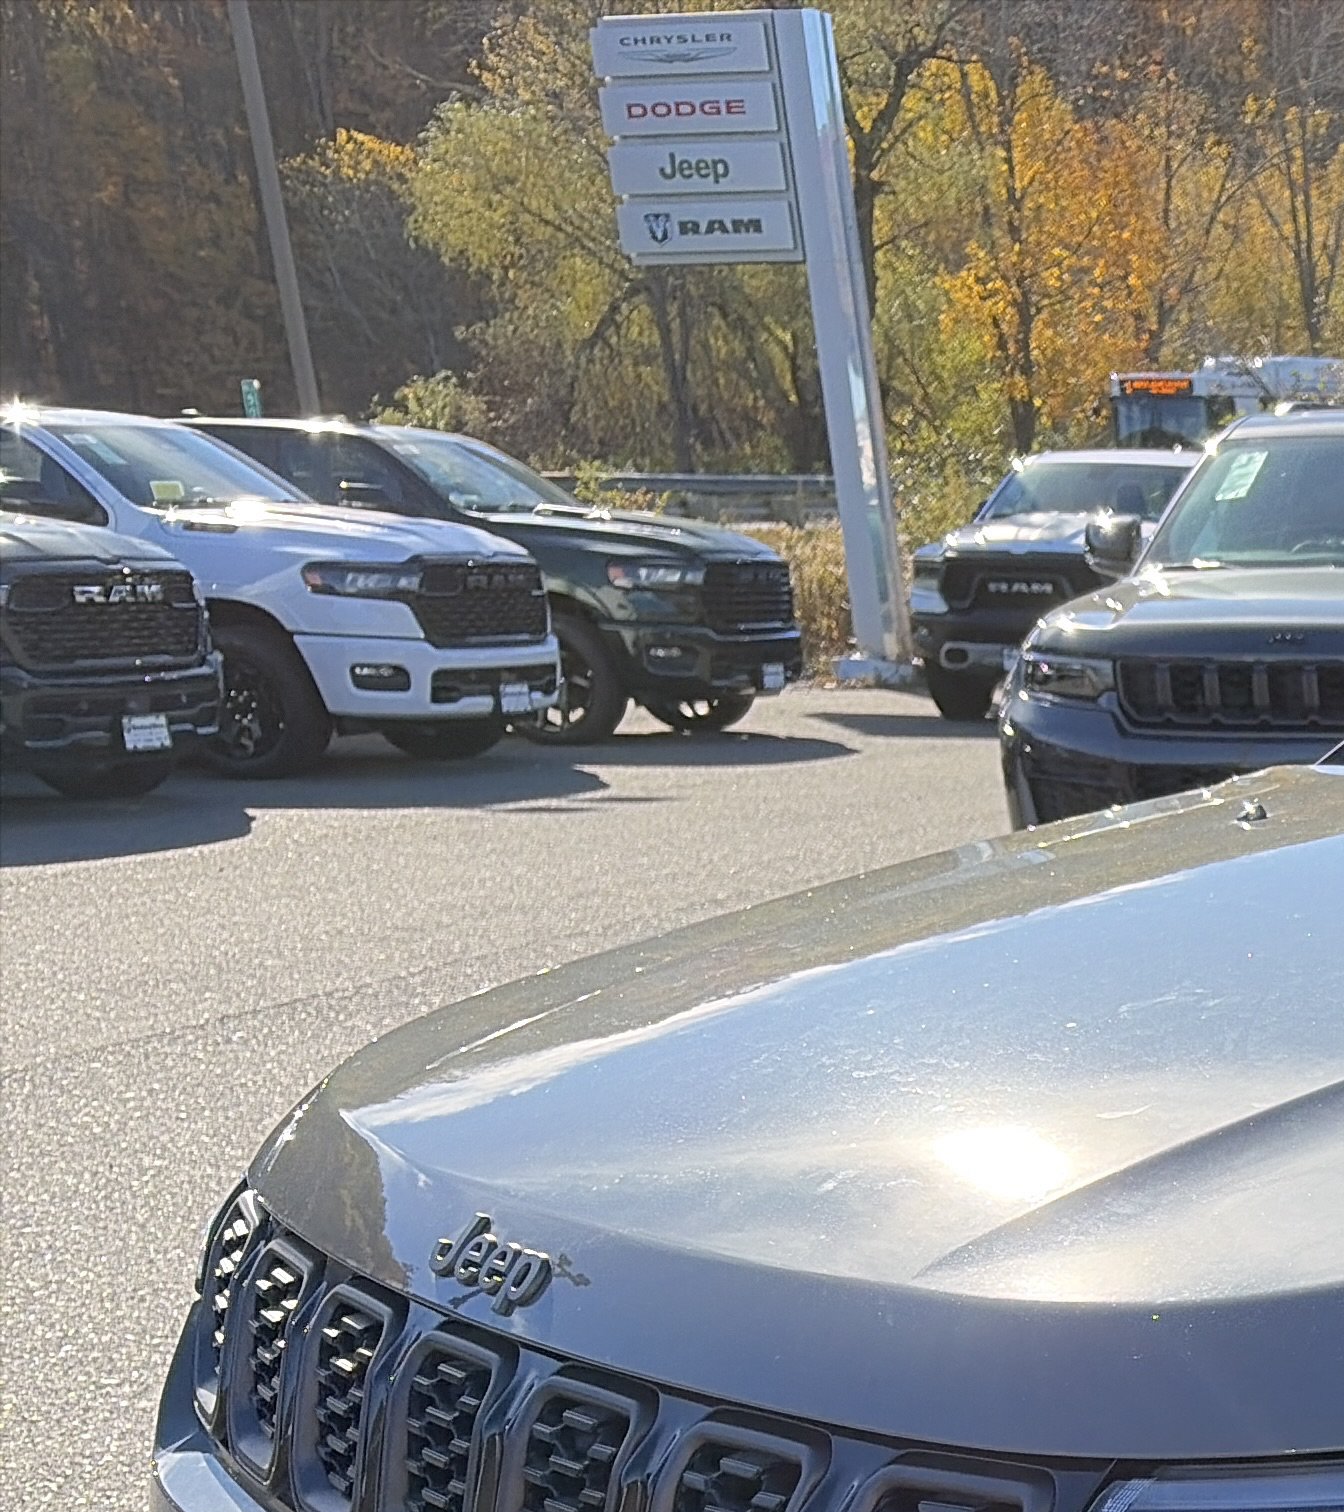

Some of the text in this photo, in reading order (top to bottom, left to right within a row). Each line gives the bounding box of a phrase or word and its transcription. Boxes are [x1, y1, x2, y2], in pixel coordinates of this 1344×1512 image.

[618, 32, 733, 47] CHRYSLER
[626, 99, 746, 119] DODGE
[658, 152, 730, 184] Jeep
[677, 218, 763, 236] RAM
[73, 584, 164, 603] RAM
[987, 581, 1053, 594] RAM
[429, 1211, 554, 1317] Jeep
